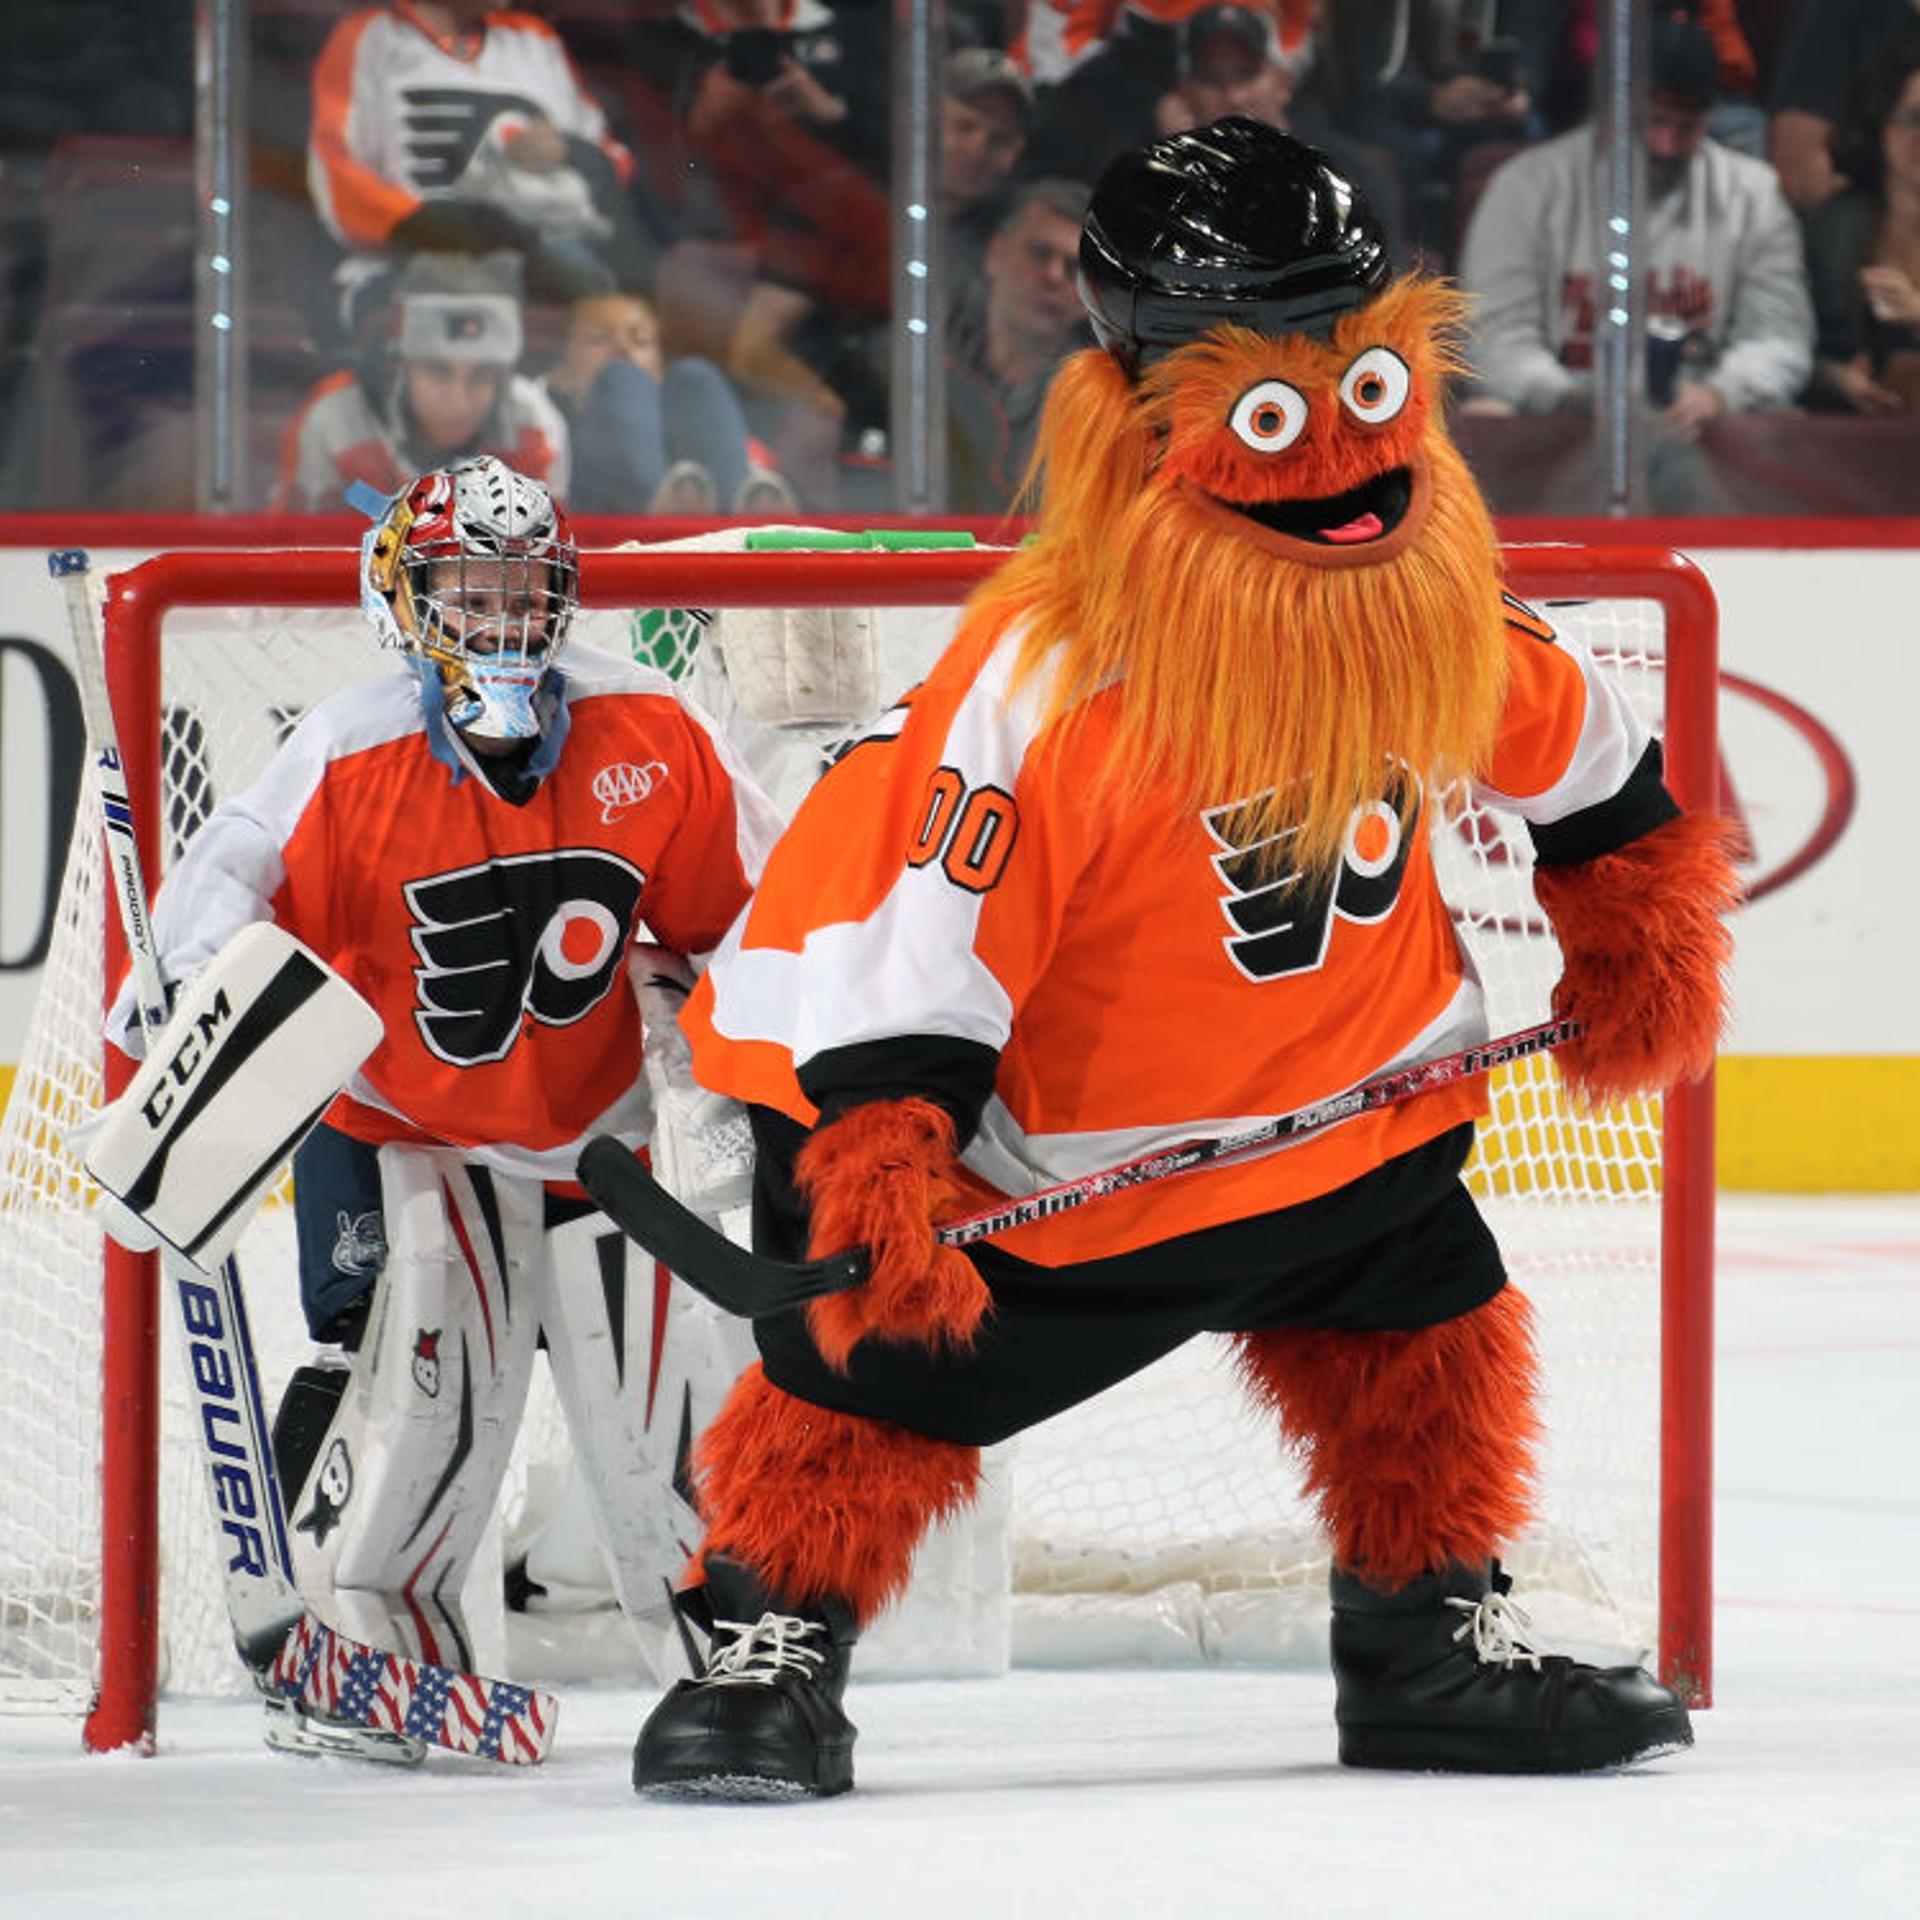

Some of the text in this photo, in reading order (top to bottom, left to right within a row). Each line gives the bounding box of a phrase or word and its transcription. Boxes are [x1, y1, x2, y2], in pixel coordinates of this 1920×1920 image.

[594, 764, 651, 805] AAA
[907, 765, 1020, 894] 00
[121, 854, 149, 956] PRODIGY
[141, 987, 232, 1129] CCM
